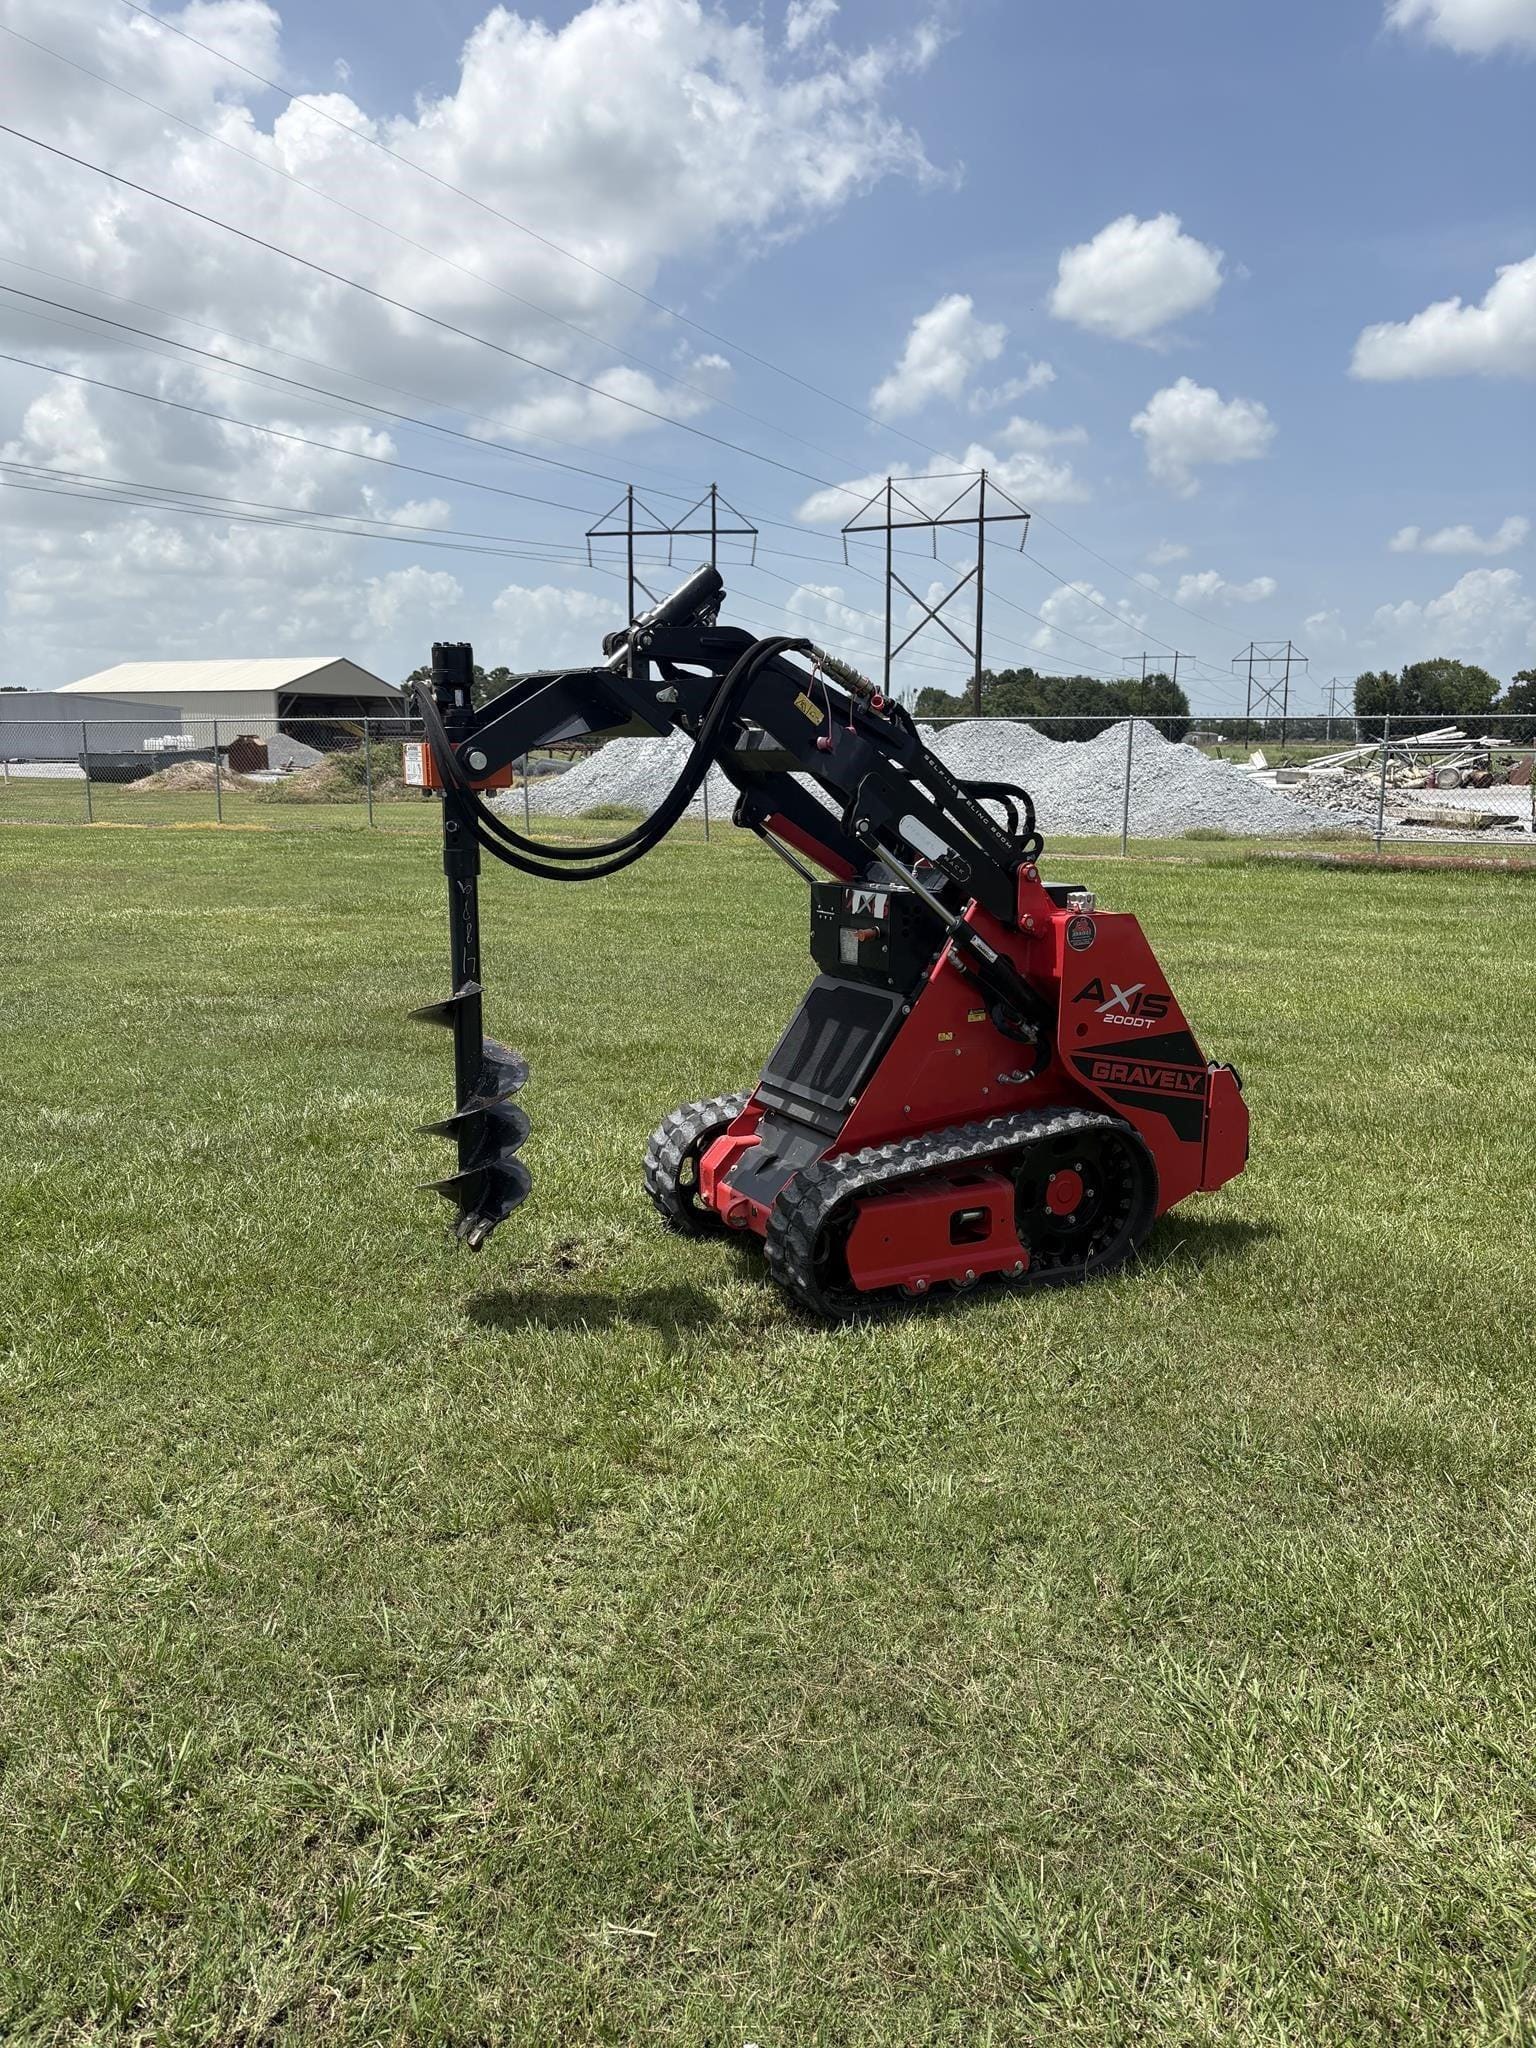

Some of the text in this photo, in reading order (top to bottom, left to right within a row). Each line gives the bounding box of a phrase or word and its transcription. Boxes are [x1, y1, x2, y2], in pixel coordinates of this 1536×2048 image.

[990, 826, 1012, 849] BOOM
[1071, 977, 1172, 1019] AXIS
[1103, 1013, 1156, 1029] 200DT
[1091, 1060, 1203, 1091] GRAVELY
